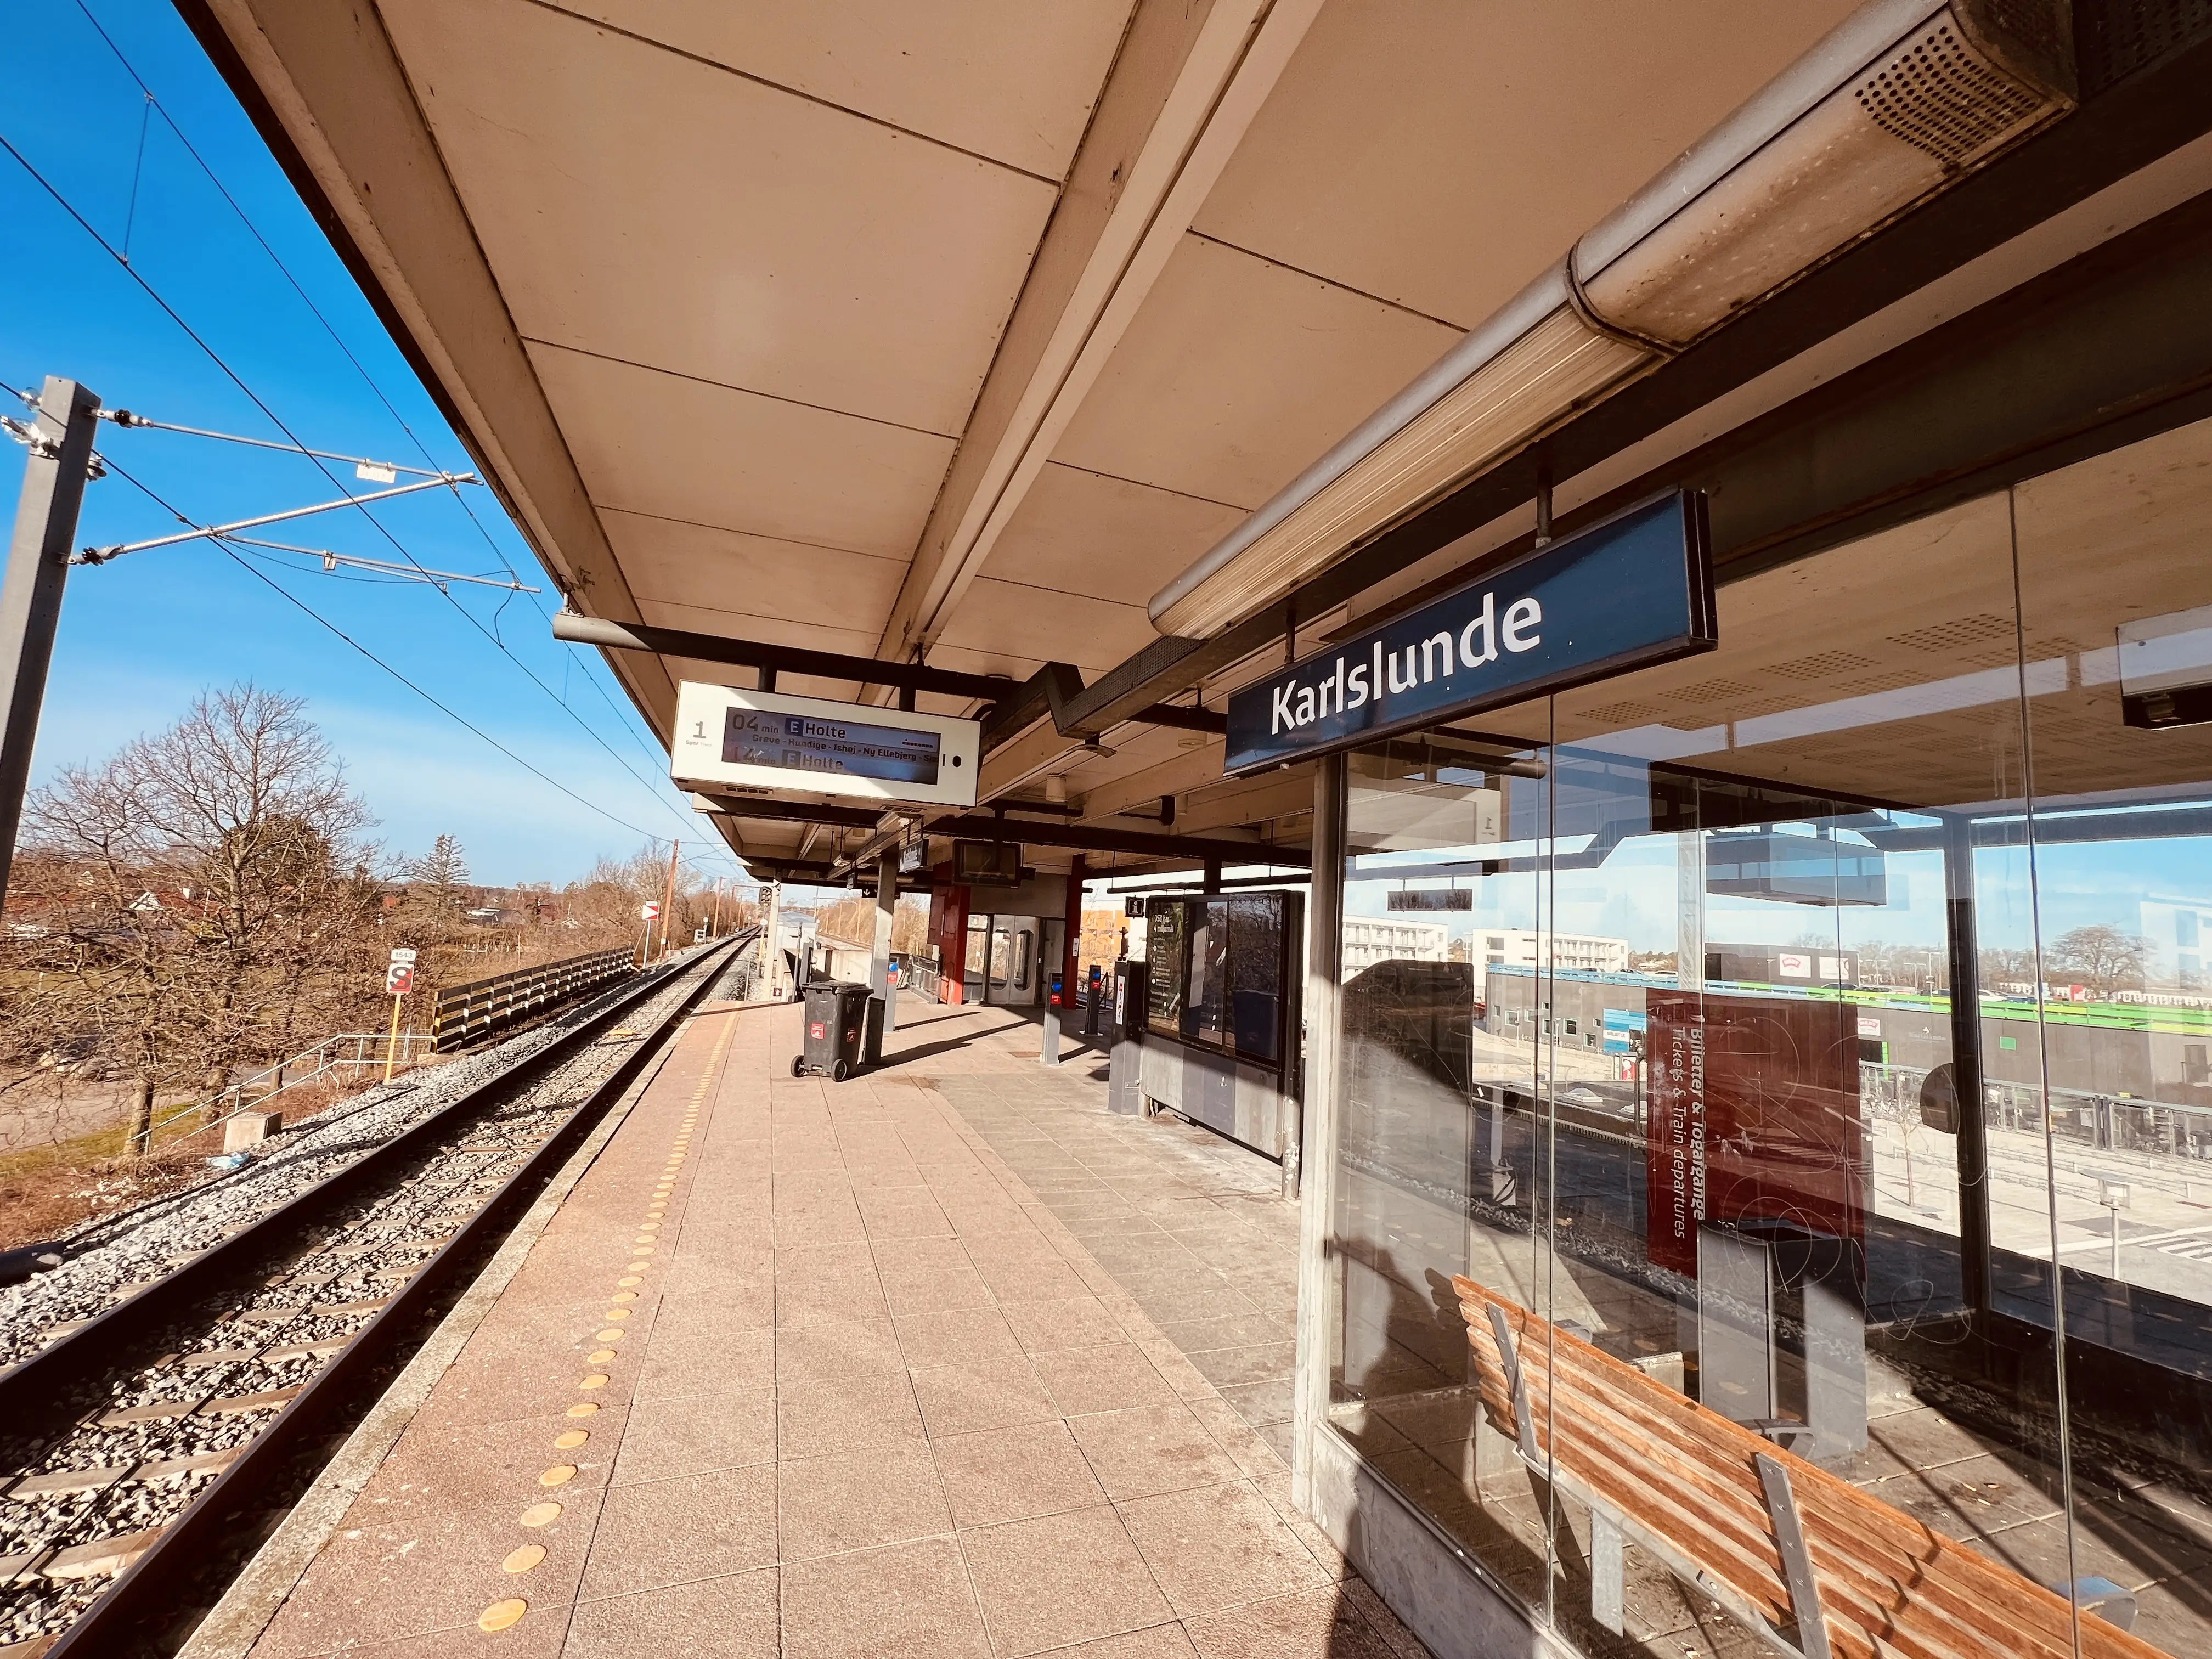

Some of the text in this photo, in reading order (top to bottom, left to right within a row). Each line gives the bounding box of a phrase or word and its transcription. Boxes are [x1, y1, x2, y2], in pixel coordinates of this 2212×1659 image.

[1271, 591, 1542, 736] Karlslunde
[693, 721, 707, 738] 1
[732, 714, 846, 738] 04 min E Holte
[752, 734, 781, 744] Greve
[788, 738, 827, 751] Hundige
[864, 747, 876, 757] Ny
[878, 749, 917, 761] Ellebjerg
[803, 754, 843, 769] Holte
[389, 966, 411, 989] S
[1691, 1028, 1705, 1097] Billetter
[1691, 1101, 1706, 1115] &
[1671, 1026, 1688, 1239] Tickets & Train departures
